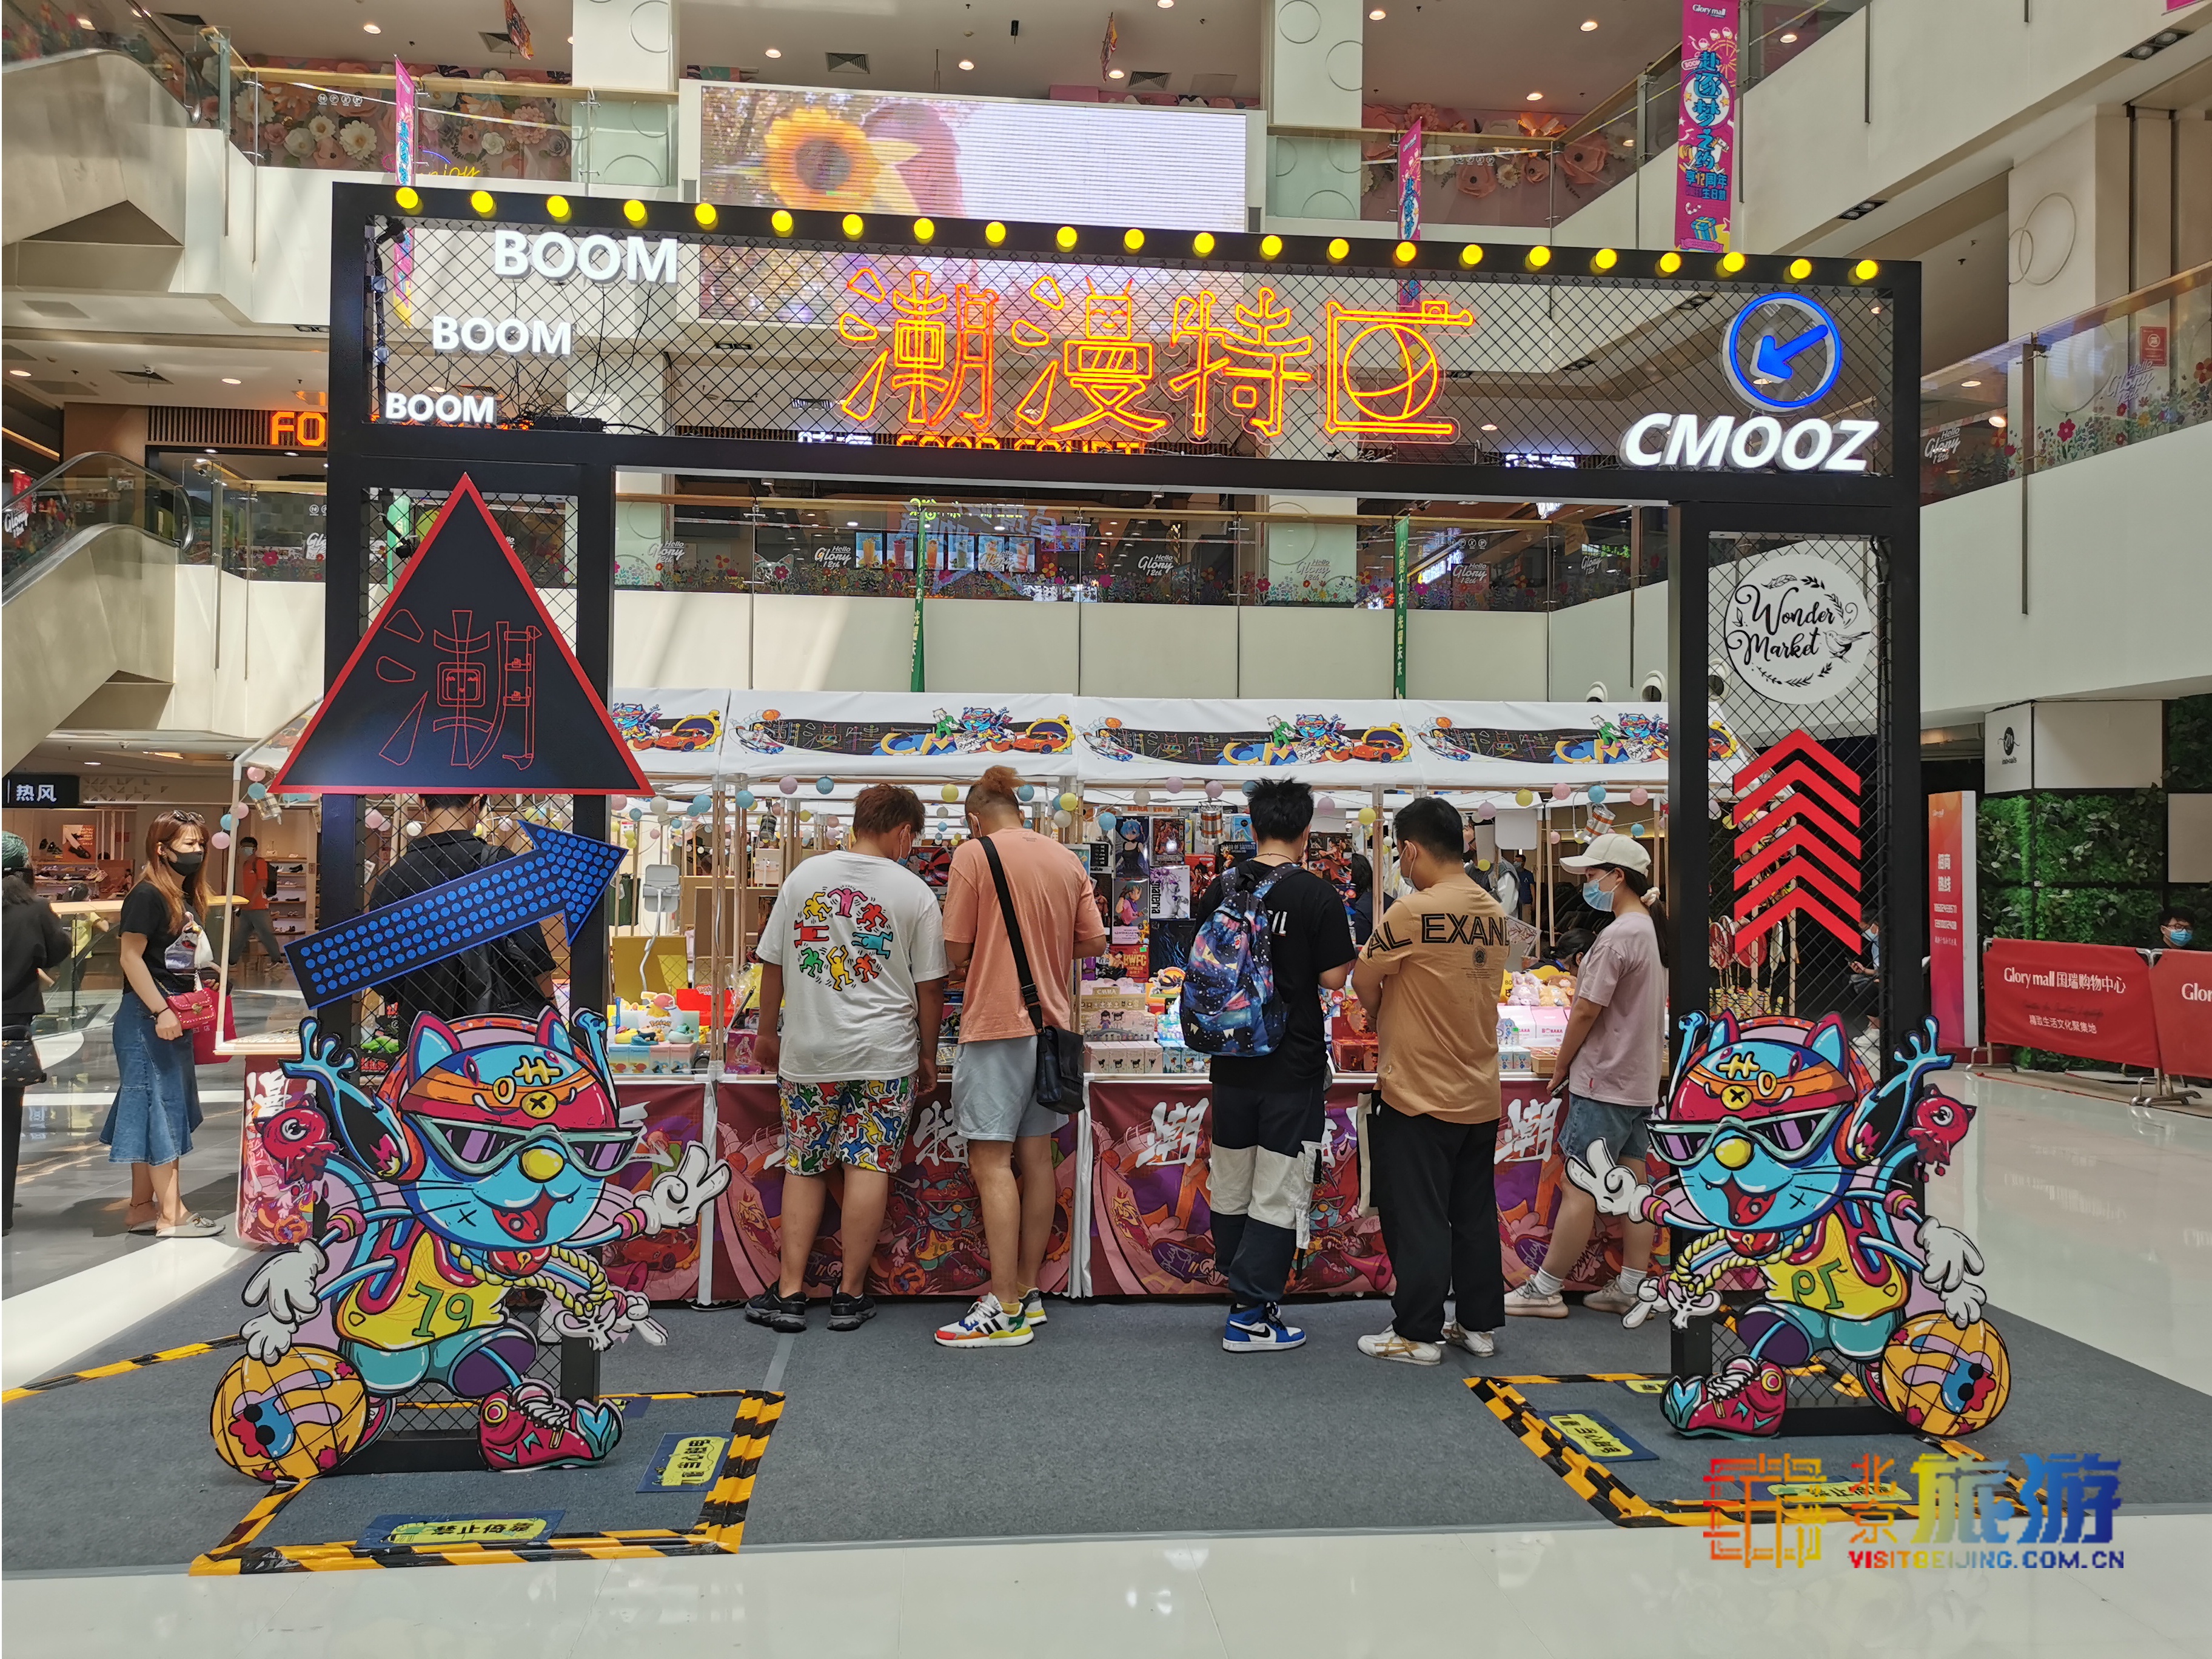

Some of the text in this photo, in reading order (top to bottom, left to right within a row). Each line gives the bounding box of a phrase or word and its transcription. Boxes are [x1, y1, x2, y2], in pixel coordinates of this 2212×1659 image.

[1692, 4, 1711, 16] Glory
[495, 229, 679, 285] BOOM
[432, 315, 573, 356] BOOM
[839, 269, 1475, 438] 潮漫特区
[385, 391, 494, 423] BOOM
[1623, 414, 1880, 472] CMOOZ
[1942, 427, 1960, 439] Hello
[814, 548, 852, 566] Glory
[1138, 556, 1174, 573] Glory
[1453, 565, 1487, 581] Glory
[1734, 584, 1835, 635] Wonder
[1727, 626, 1821, 666] Market
[375, 609, 542, 771] 潮
[16, 784, 57, 803] 热风
[1123, 954, 1147, 967] BWFC
[2003, 967, 2127, 994] Glory mall 国瑞购物中心
